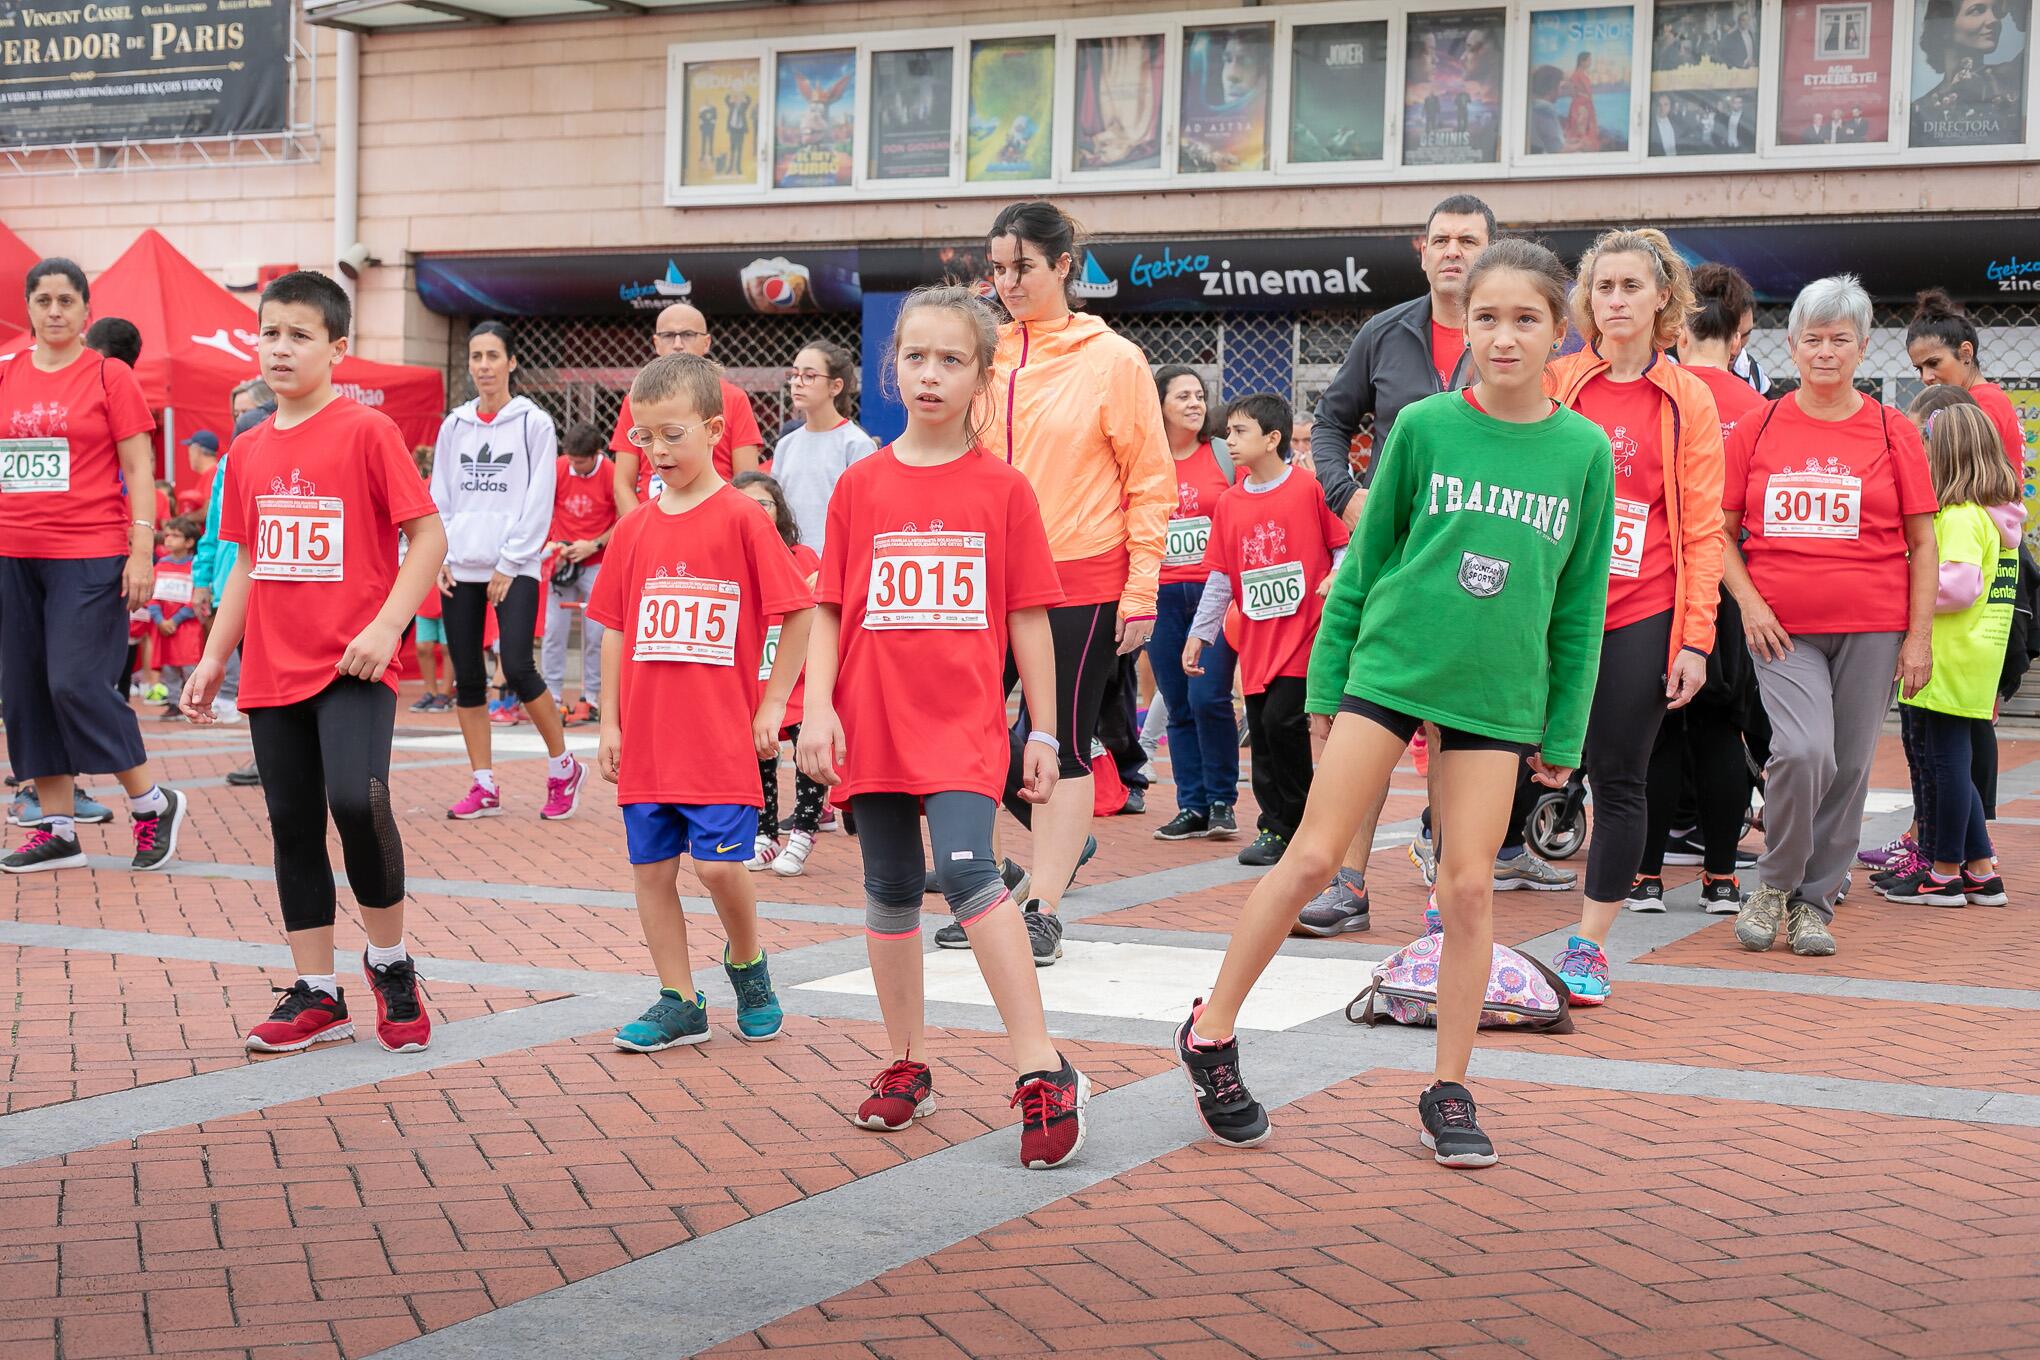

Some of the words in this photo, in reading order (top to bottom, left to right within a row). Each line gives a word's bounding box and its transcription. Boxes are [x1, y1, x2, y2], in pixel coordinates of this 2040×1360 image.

[0, 32, 120, 66] ERADOR
[126, 36, 146, 50] DE
[150, 22, 245, 60] PARIS
[1129, 246, 1209, 287] Getxo
[1199, 256, 1372, 296] zinemak
[3, 453, 61, 479] 2053
[1774, 490, 1850, 523] 3015
[258, 519, 331, 561] 3015
[1166, 530, 1207, 555] 006
[876, 560, 975, 607] 3015
[1249, 577, 1300, 609] 2006
[1468, 571, 1496, 585] SPORTS
[644, 599, 726, 643] 3015
